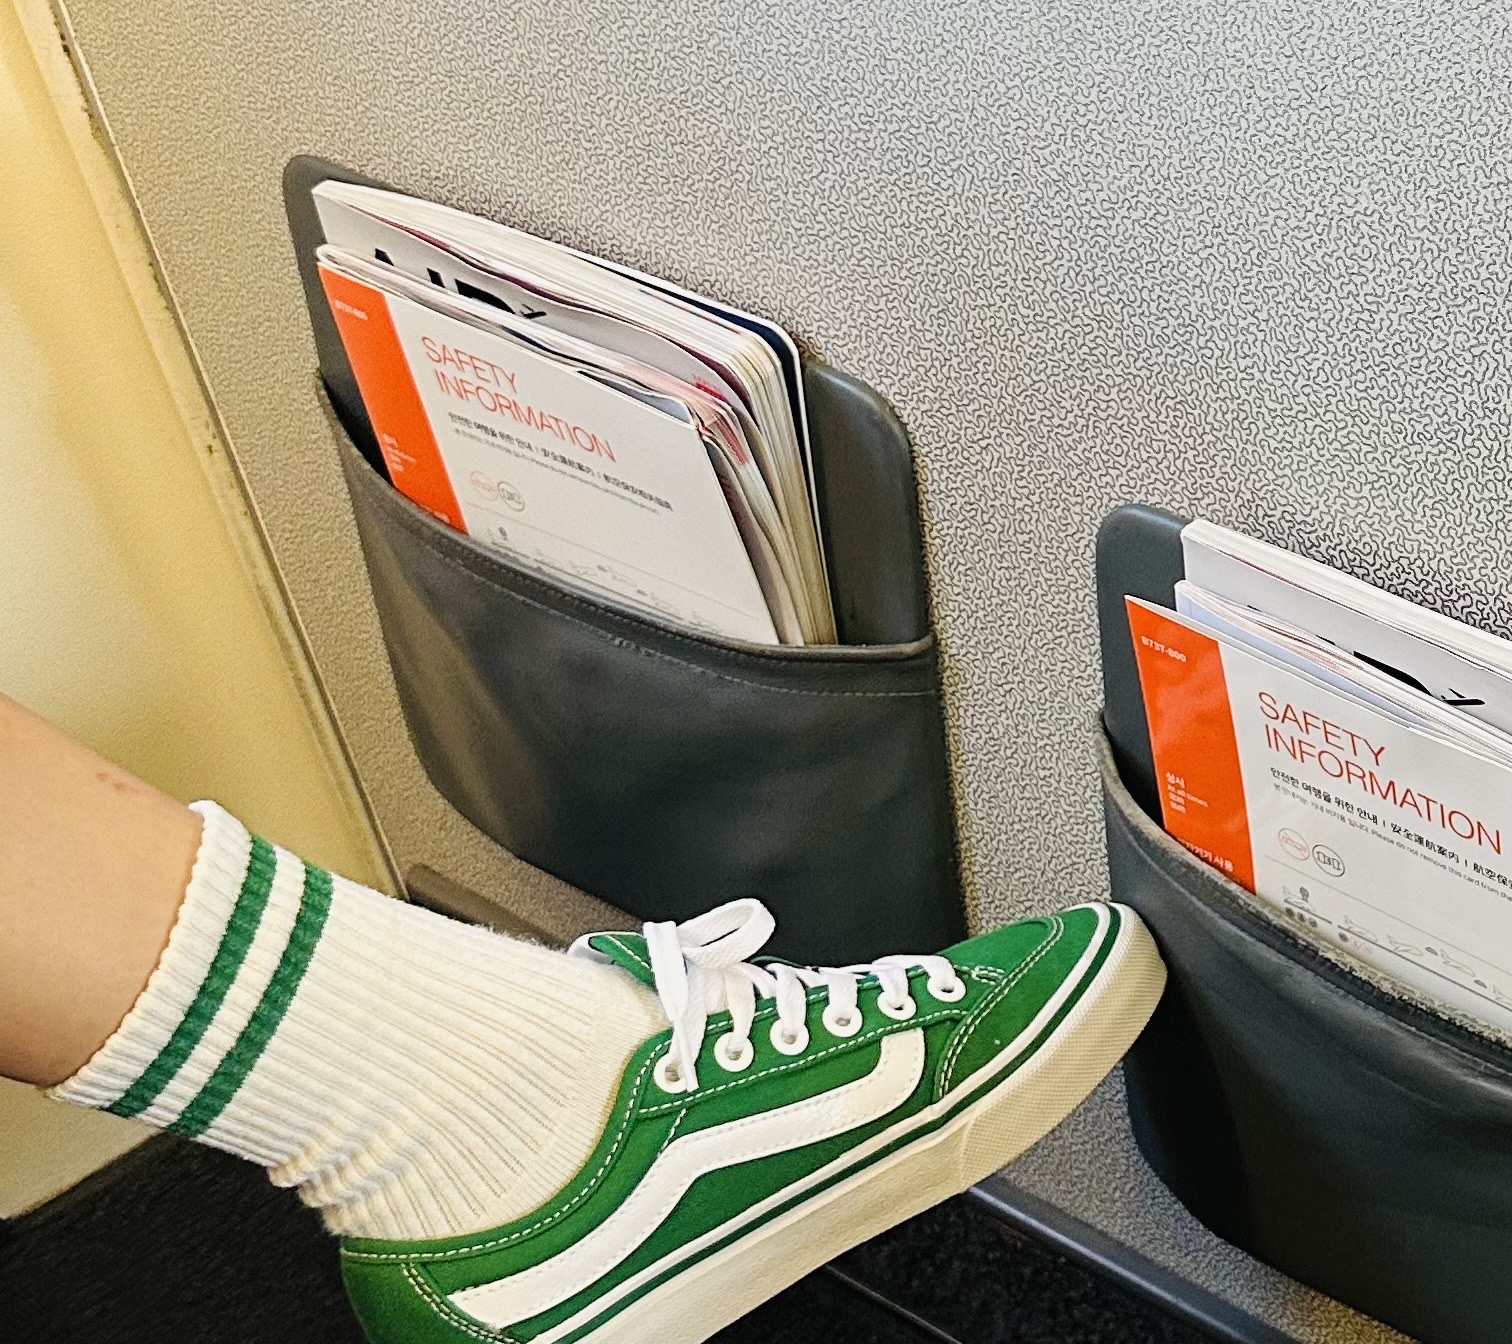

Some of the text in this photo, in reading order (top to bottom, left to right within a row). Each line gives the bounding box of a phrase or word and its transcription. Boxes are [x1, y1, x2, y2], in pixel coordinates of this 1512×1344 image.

[422, 336, 517, 393] SAFETY
[434, 369, 616, 463] INFORMATION
[1258, 691, 1385, 766] SAFETY
[1264, 724, 1502, 855] INFORMATION
